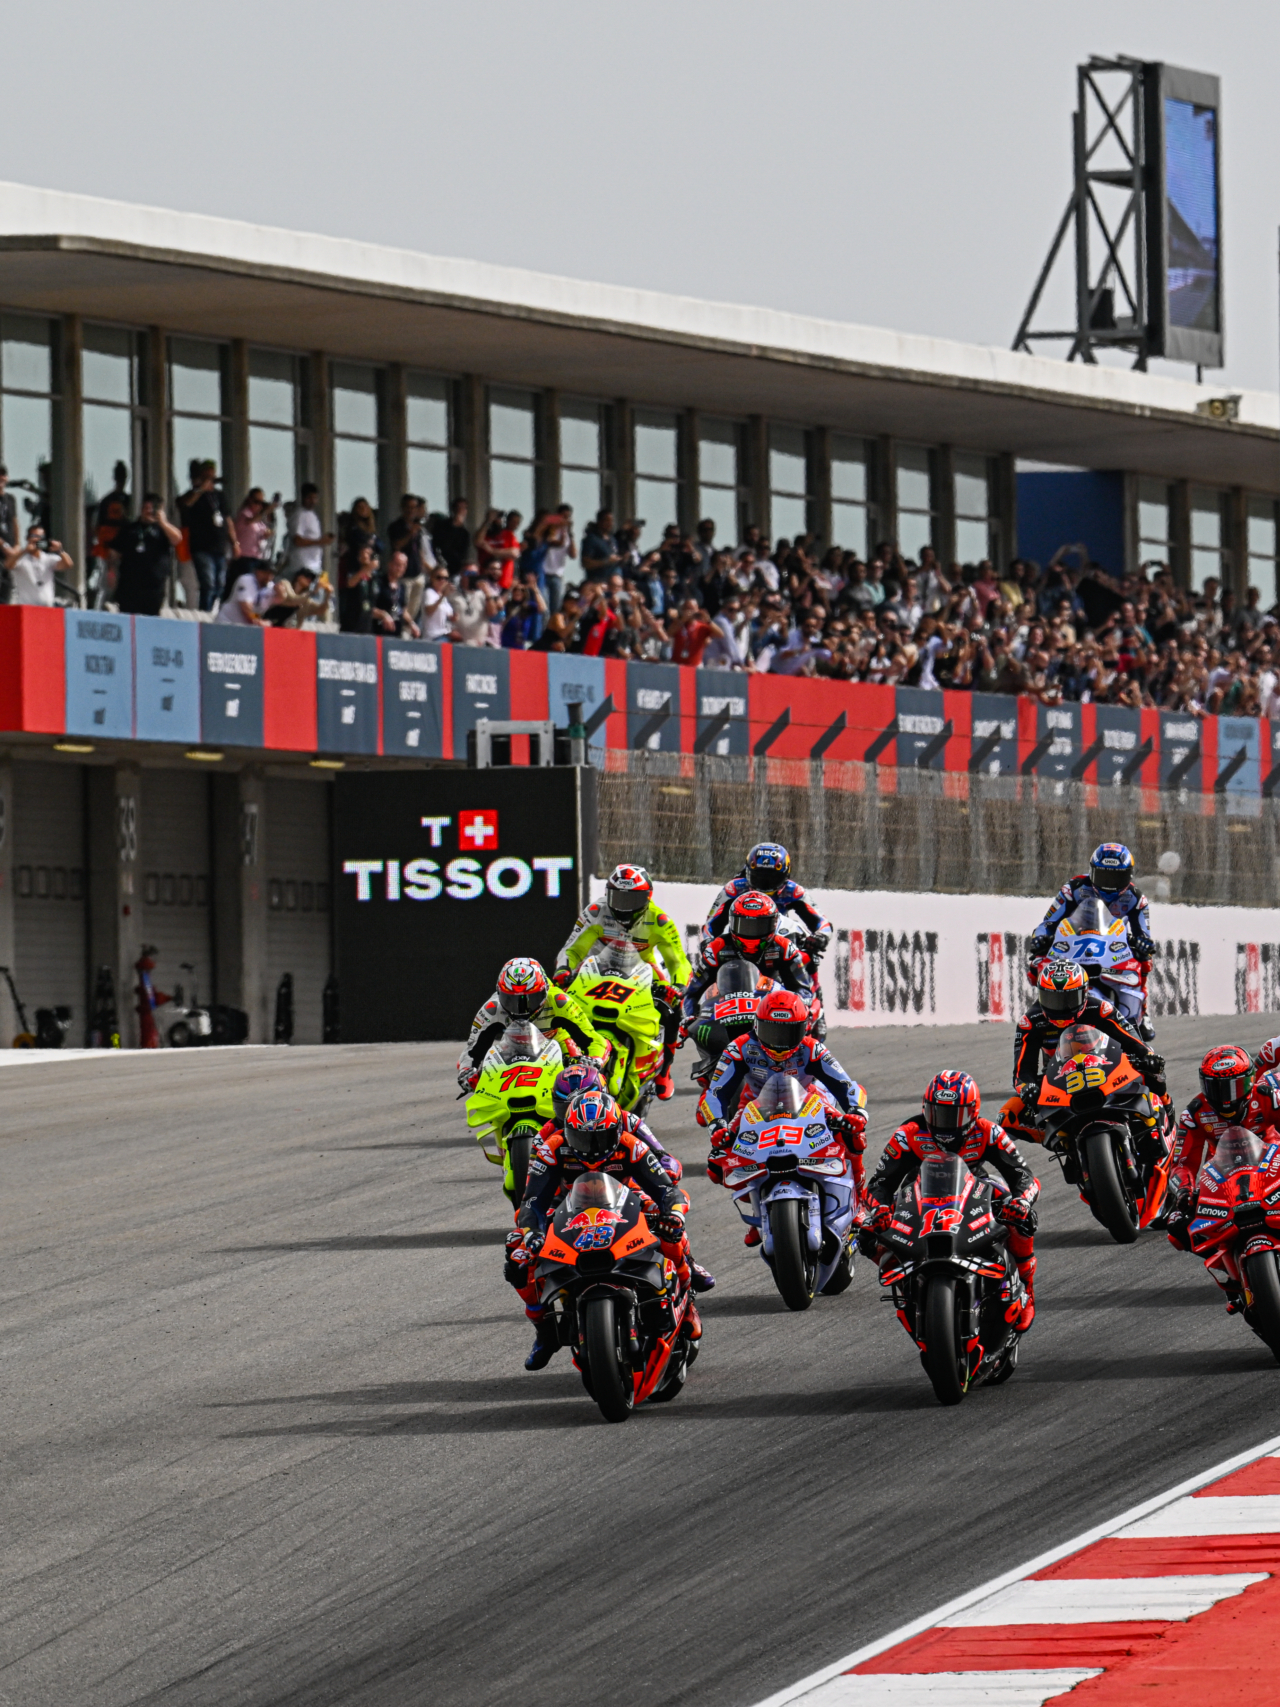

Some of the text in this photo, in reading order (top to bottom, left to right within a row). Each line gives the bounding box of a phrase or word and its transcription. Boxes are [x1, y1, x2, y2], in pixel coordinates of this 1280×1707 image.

[420, 816, 452, 848] T
[343, 856, 575, 902] TISSOT
[1072, 937, 1108, 959] 73
[604, 969, 623, 977] ebay
[864, 930, 939, 1014] TISSOT
[583, 980, 637, 1005] 49
[724, 991, 755, 1001] ENEOS
[715, 997, 762, 1020] 20
[719, 1014, 755, 1025] MONSTE
[511, 1055, 531, 1063] ebay
[499, 1065, 543, 1092] 72
[1065, 1067, 1107, 1094] 33
[1110, 1074, 1130, 1088] KTM
[936, 1089, 956, 1100] Arai
[1045, 1094, 1061, 1103] KTM
[769, 1112, 793, 1120] Kapriol
[757, 1125, 804, 1150] 93
[808, 1134, 832, 1150] Unibat
[733, 1143, 755, 1157] Unibat
[1236, 1173, 1255, 1203] 1
[900, 1210, 913, 1221] sky
[970, 1205, 984, 1217] sky
[1197, 1205, 1228, 1218] Lenovo
[918, 1208, 965, 1239] 12
[1199, 1220, 1212, 1229] TIM
[572, 1224, 616, 1252] 43
[891, 1234, 908, 1245] CASE
[967, 1230, 985, 1243] CASE
[625, 1237, 645, 1252] KTM
[548, 1248, 566, 1260] KTM
